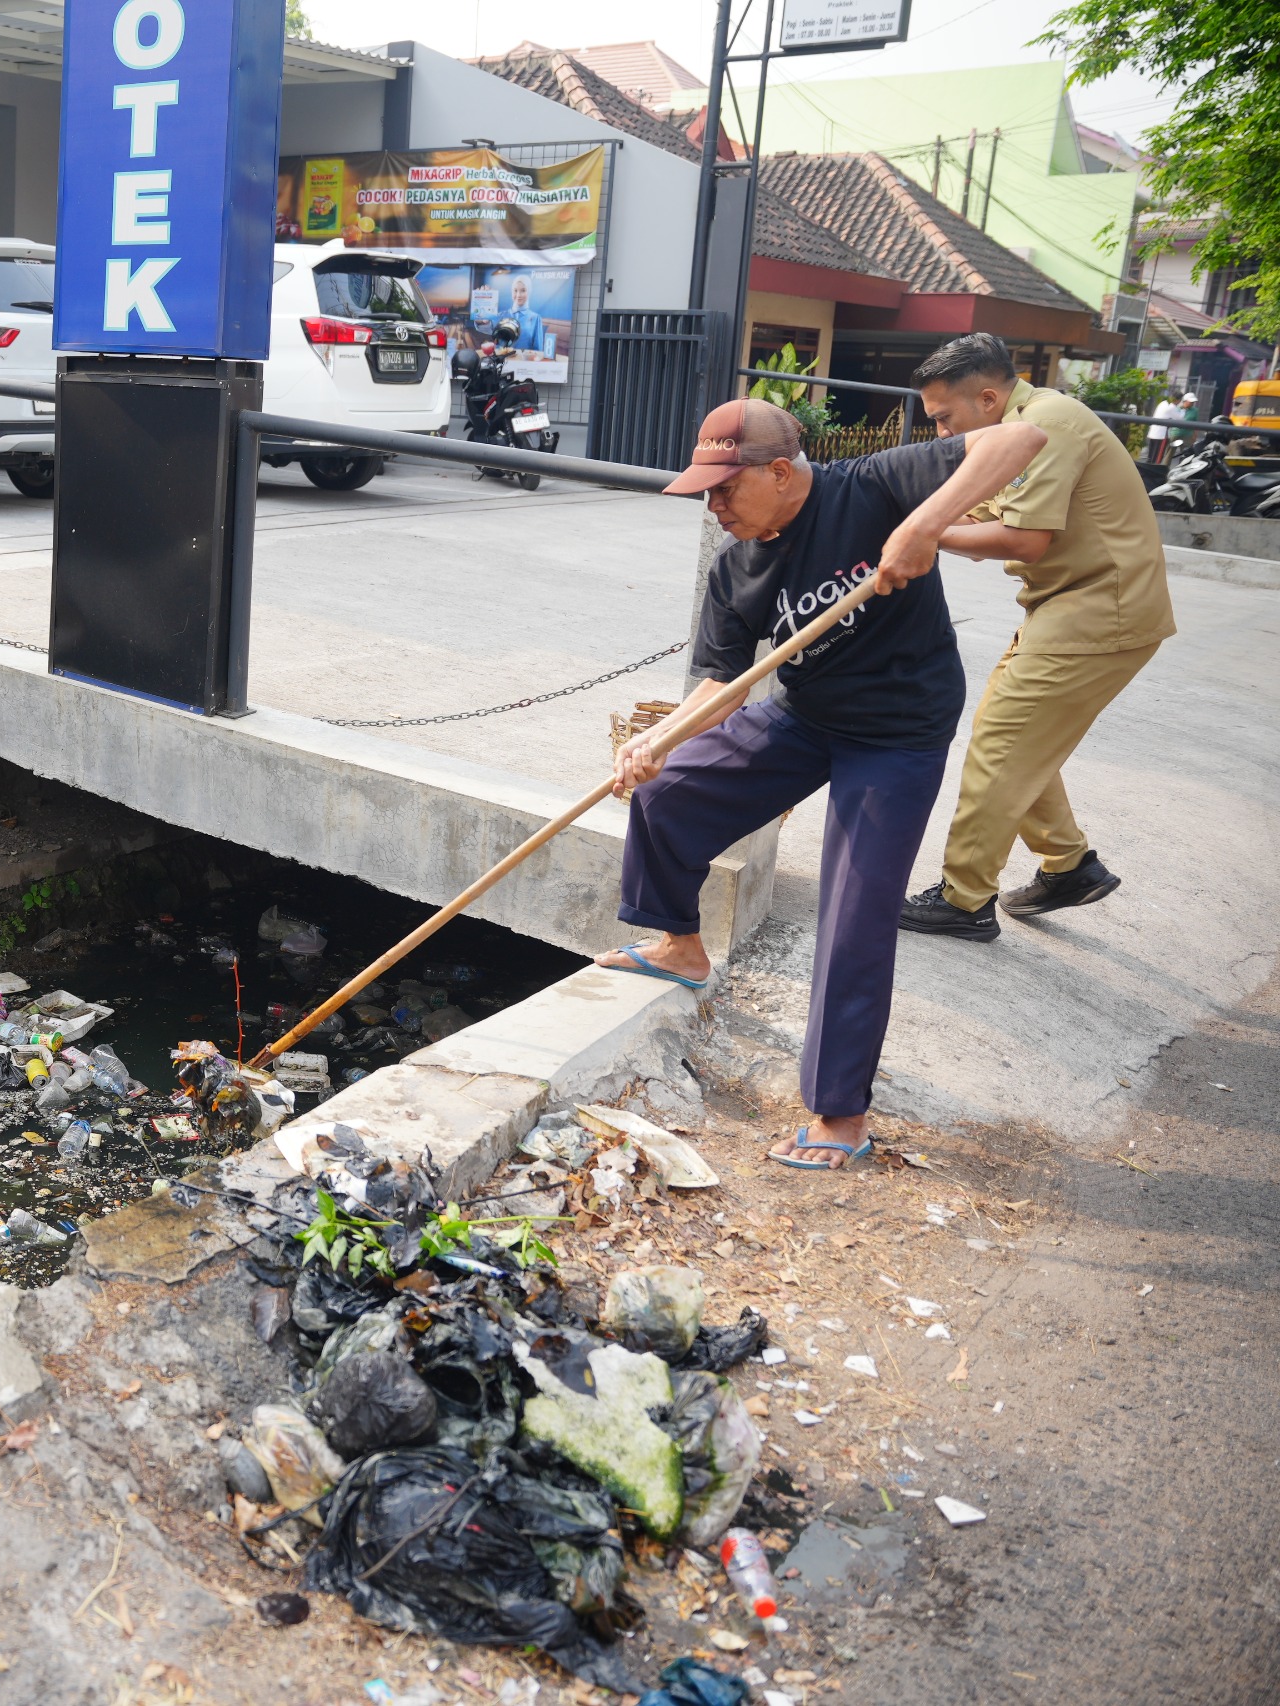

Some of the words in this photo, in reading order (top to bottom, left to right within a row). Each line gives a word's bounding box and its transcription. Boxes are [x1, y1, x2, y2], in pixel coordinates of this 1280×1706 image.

[827, 0, 853, 8] Praktek
[786, 20, 796, 29] Pagi
[802, 19, 815, 27] Senin
[820, 17, 833, 25] Sabtu
[842, 15, 858, 23] Malam
[862, 13, 876, 21] Senin
[880, 11, 896, 19] Jumat
[104, 0, 185, 332] OTEK
[410, 168, 462, 181] MIXAGRIP
[466, 169, 495, 180] Herbal
[357, 191, 402, 204] COCOK!
[406, 189, 465, 203] PEDASNYA
[470, 189, 516, 203] COCOK!
[430, 209, 456, 220] UNTUK
[480, 209, 507, 220] ANGIN
[772, 560, 879, 666] Jogja
[805, 640, 832, 658] Tradisi
